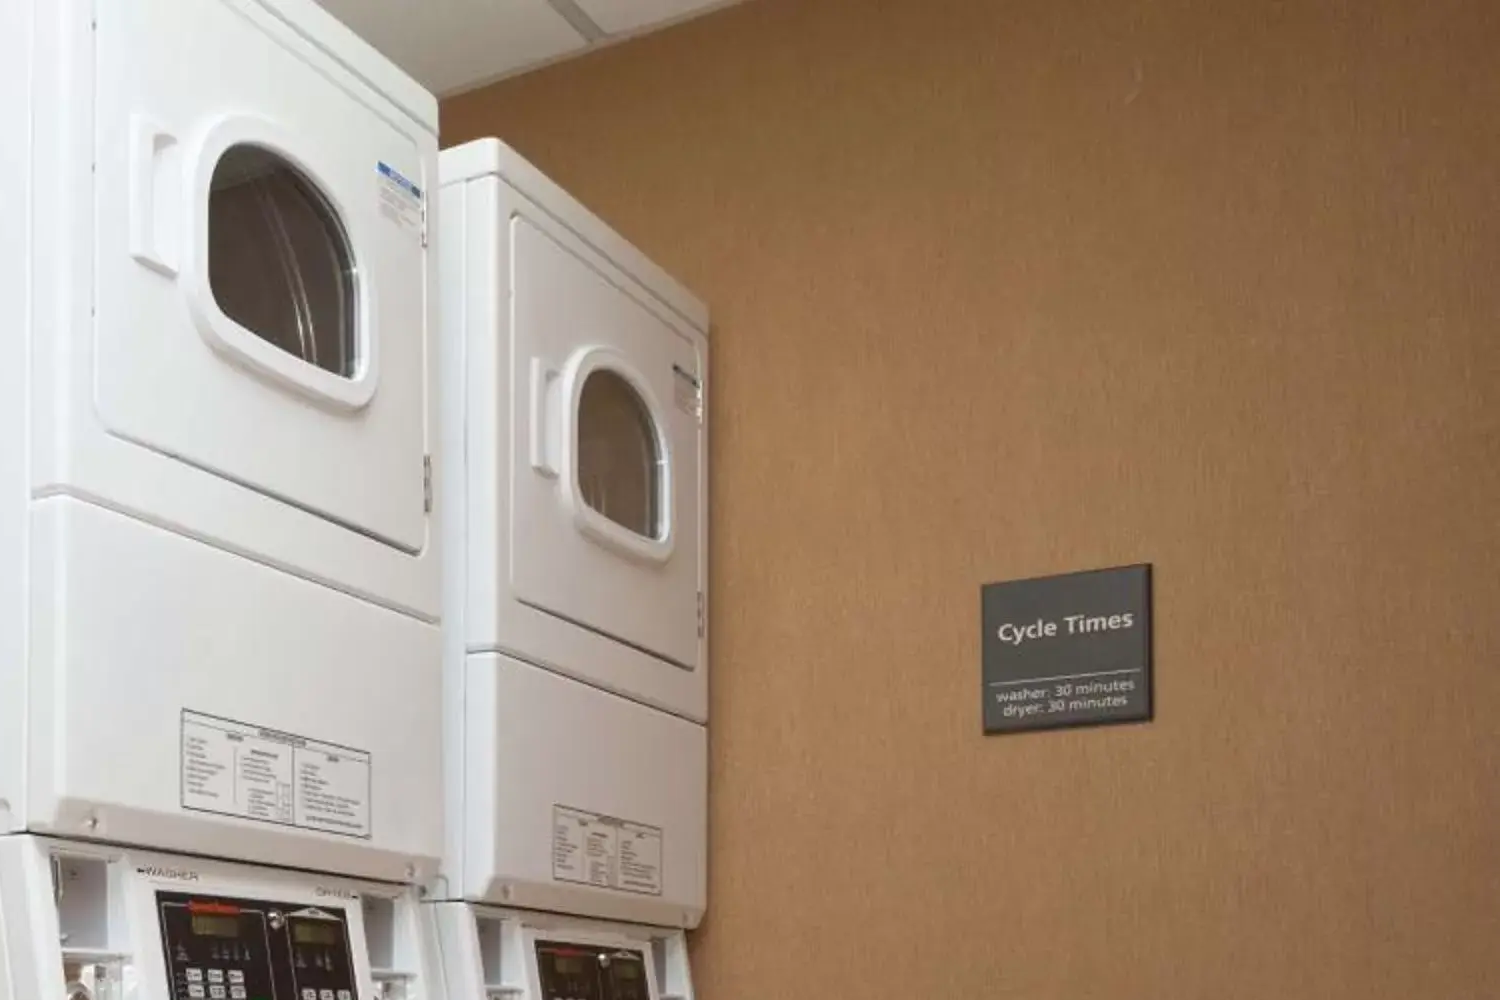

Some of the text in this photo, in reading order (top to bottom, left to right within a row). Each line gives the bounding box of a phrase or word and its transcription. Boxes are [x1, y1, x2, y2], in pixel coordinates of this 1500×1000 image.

[997, 612, 1134, 646] Cycle Times
[1054, 683, 1073, 697] 30
[1075, 679, 1135, 695] minutes
[1047, 699, 1065, 713] 30
[1069, 695, 1128, 711] minutes
